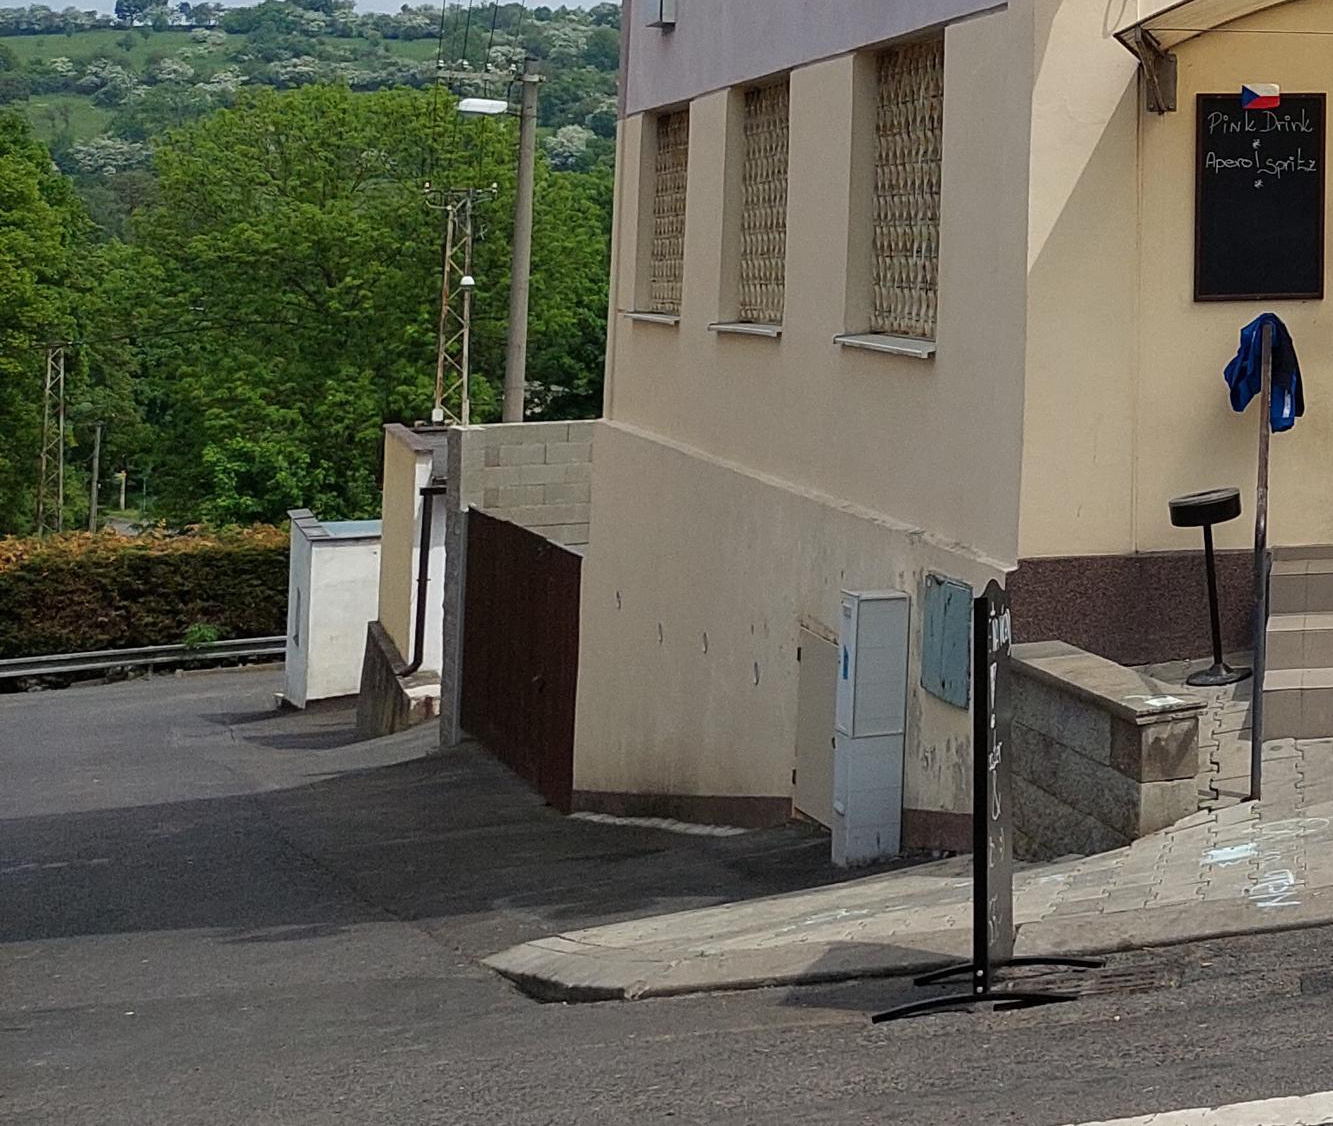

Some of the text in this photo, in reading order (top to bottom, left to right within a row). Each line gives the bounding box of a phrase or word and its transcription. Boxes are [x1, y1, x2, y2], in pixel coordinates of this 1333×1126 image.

[1208, 108, 1313, 134] Pink Drink
[1205, 151, 1260, 174] Aperol
